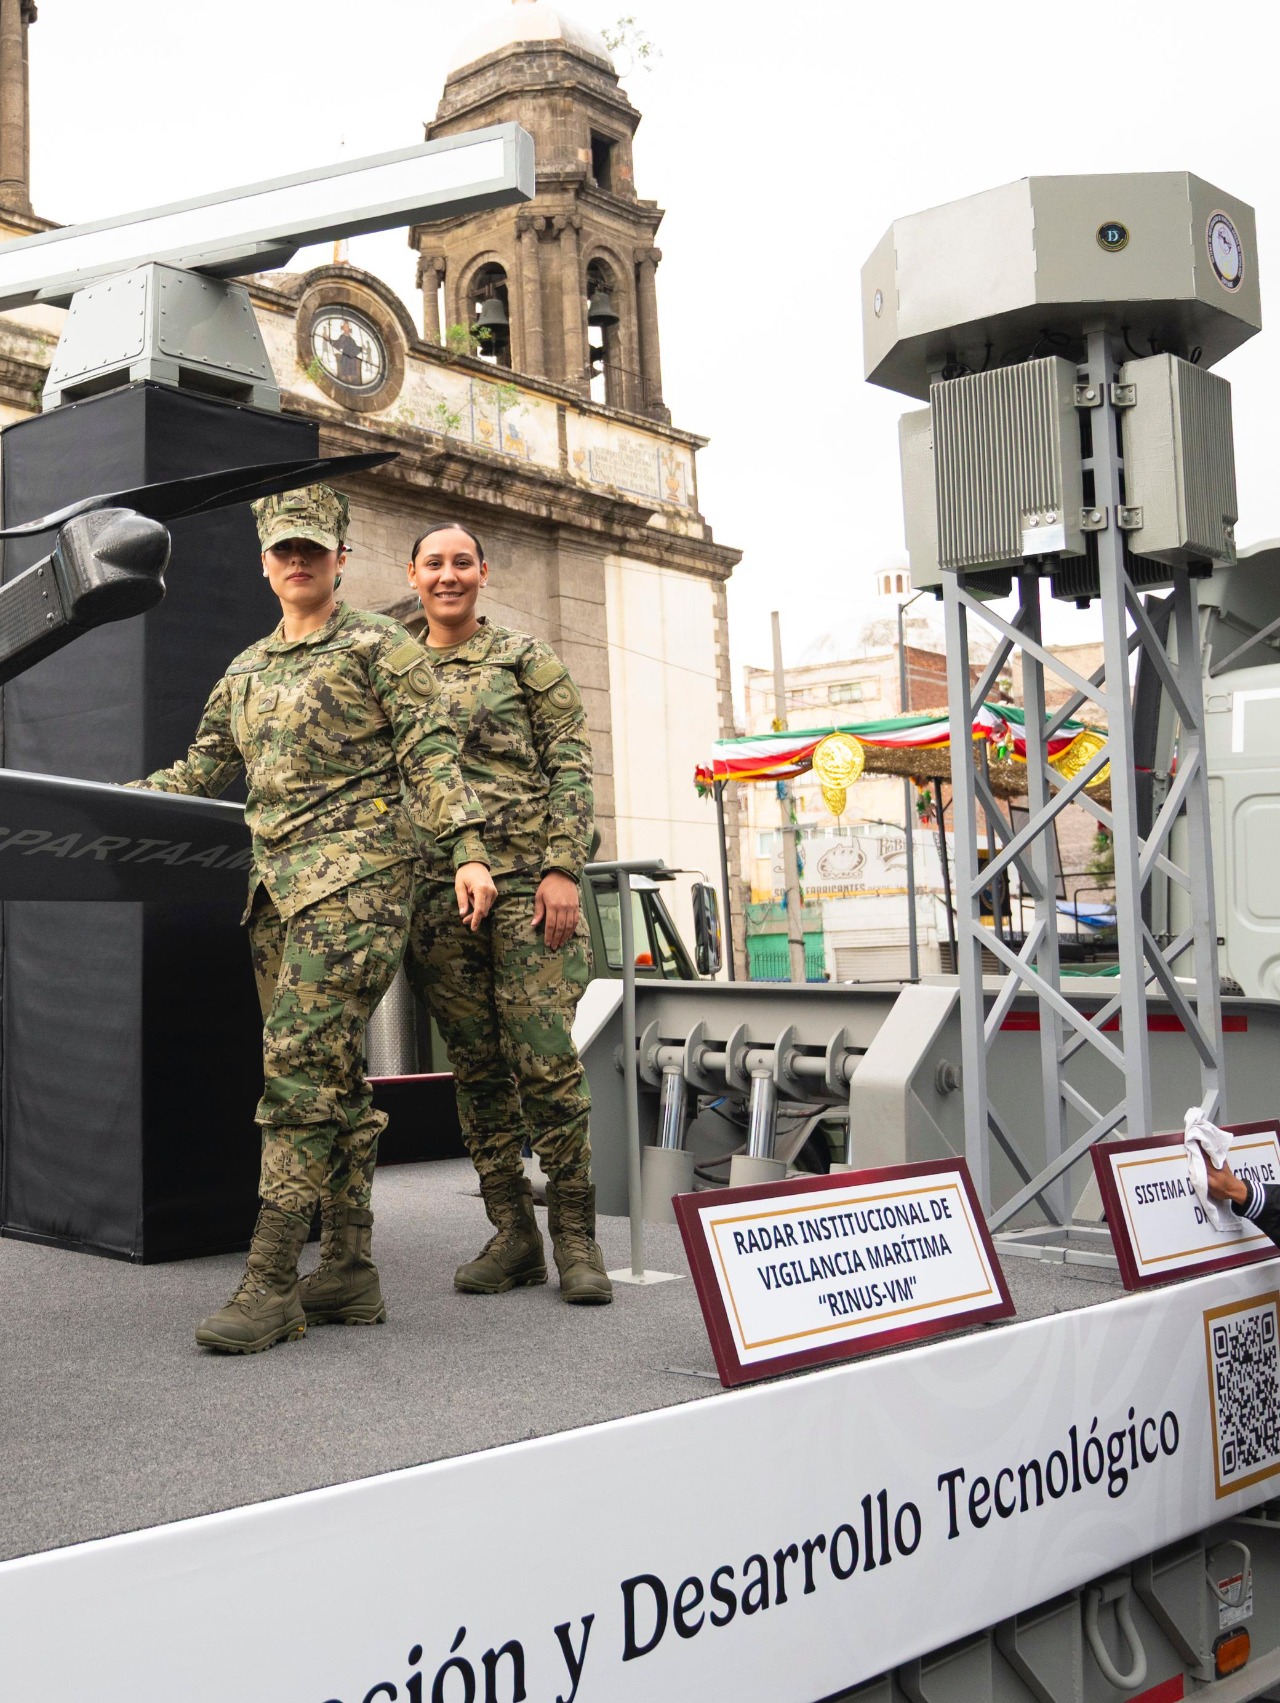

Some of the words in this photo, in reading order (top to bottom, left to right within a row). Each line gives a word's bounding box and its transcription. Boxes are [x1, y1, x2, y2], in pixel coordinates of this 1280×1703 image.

[1134, 1179, 1186, 1205] SISTEMA
[1260, 1163, 1276, 1182] DE
[732, 1222, 799, 1255] RADAR
[797, 1201, 930, 1244] INSTITUCIONAL
[929, 1197, 953, 1221] DE
[757, 1249, 867, 1291] VIGILANCIA
[866, 1234, 953, 1270] MARÍTIMA
[553, 1612, 596, 1703] y
[620, 1488, 923, 1662] Desarrollo
[936, 1409, 1181, 1541] Tecnológico
